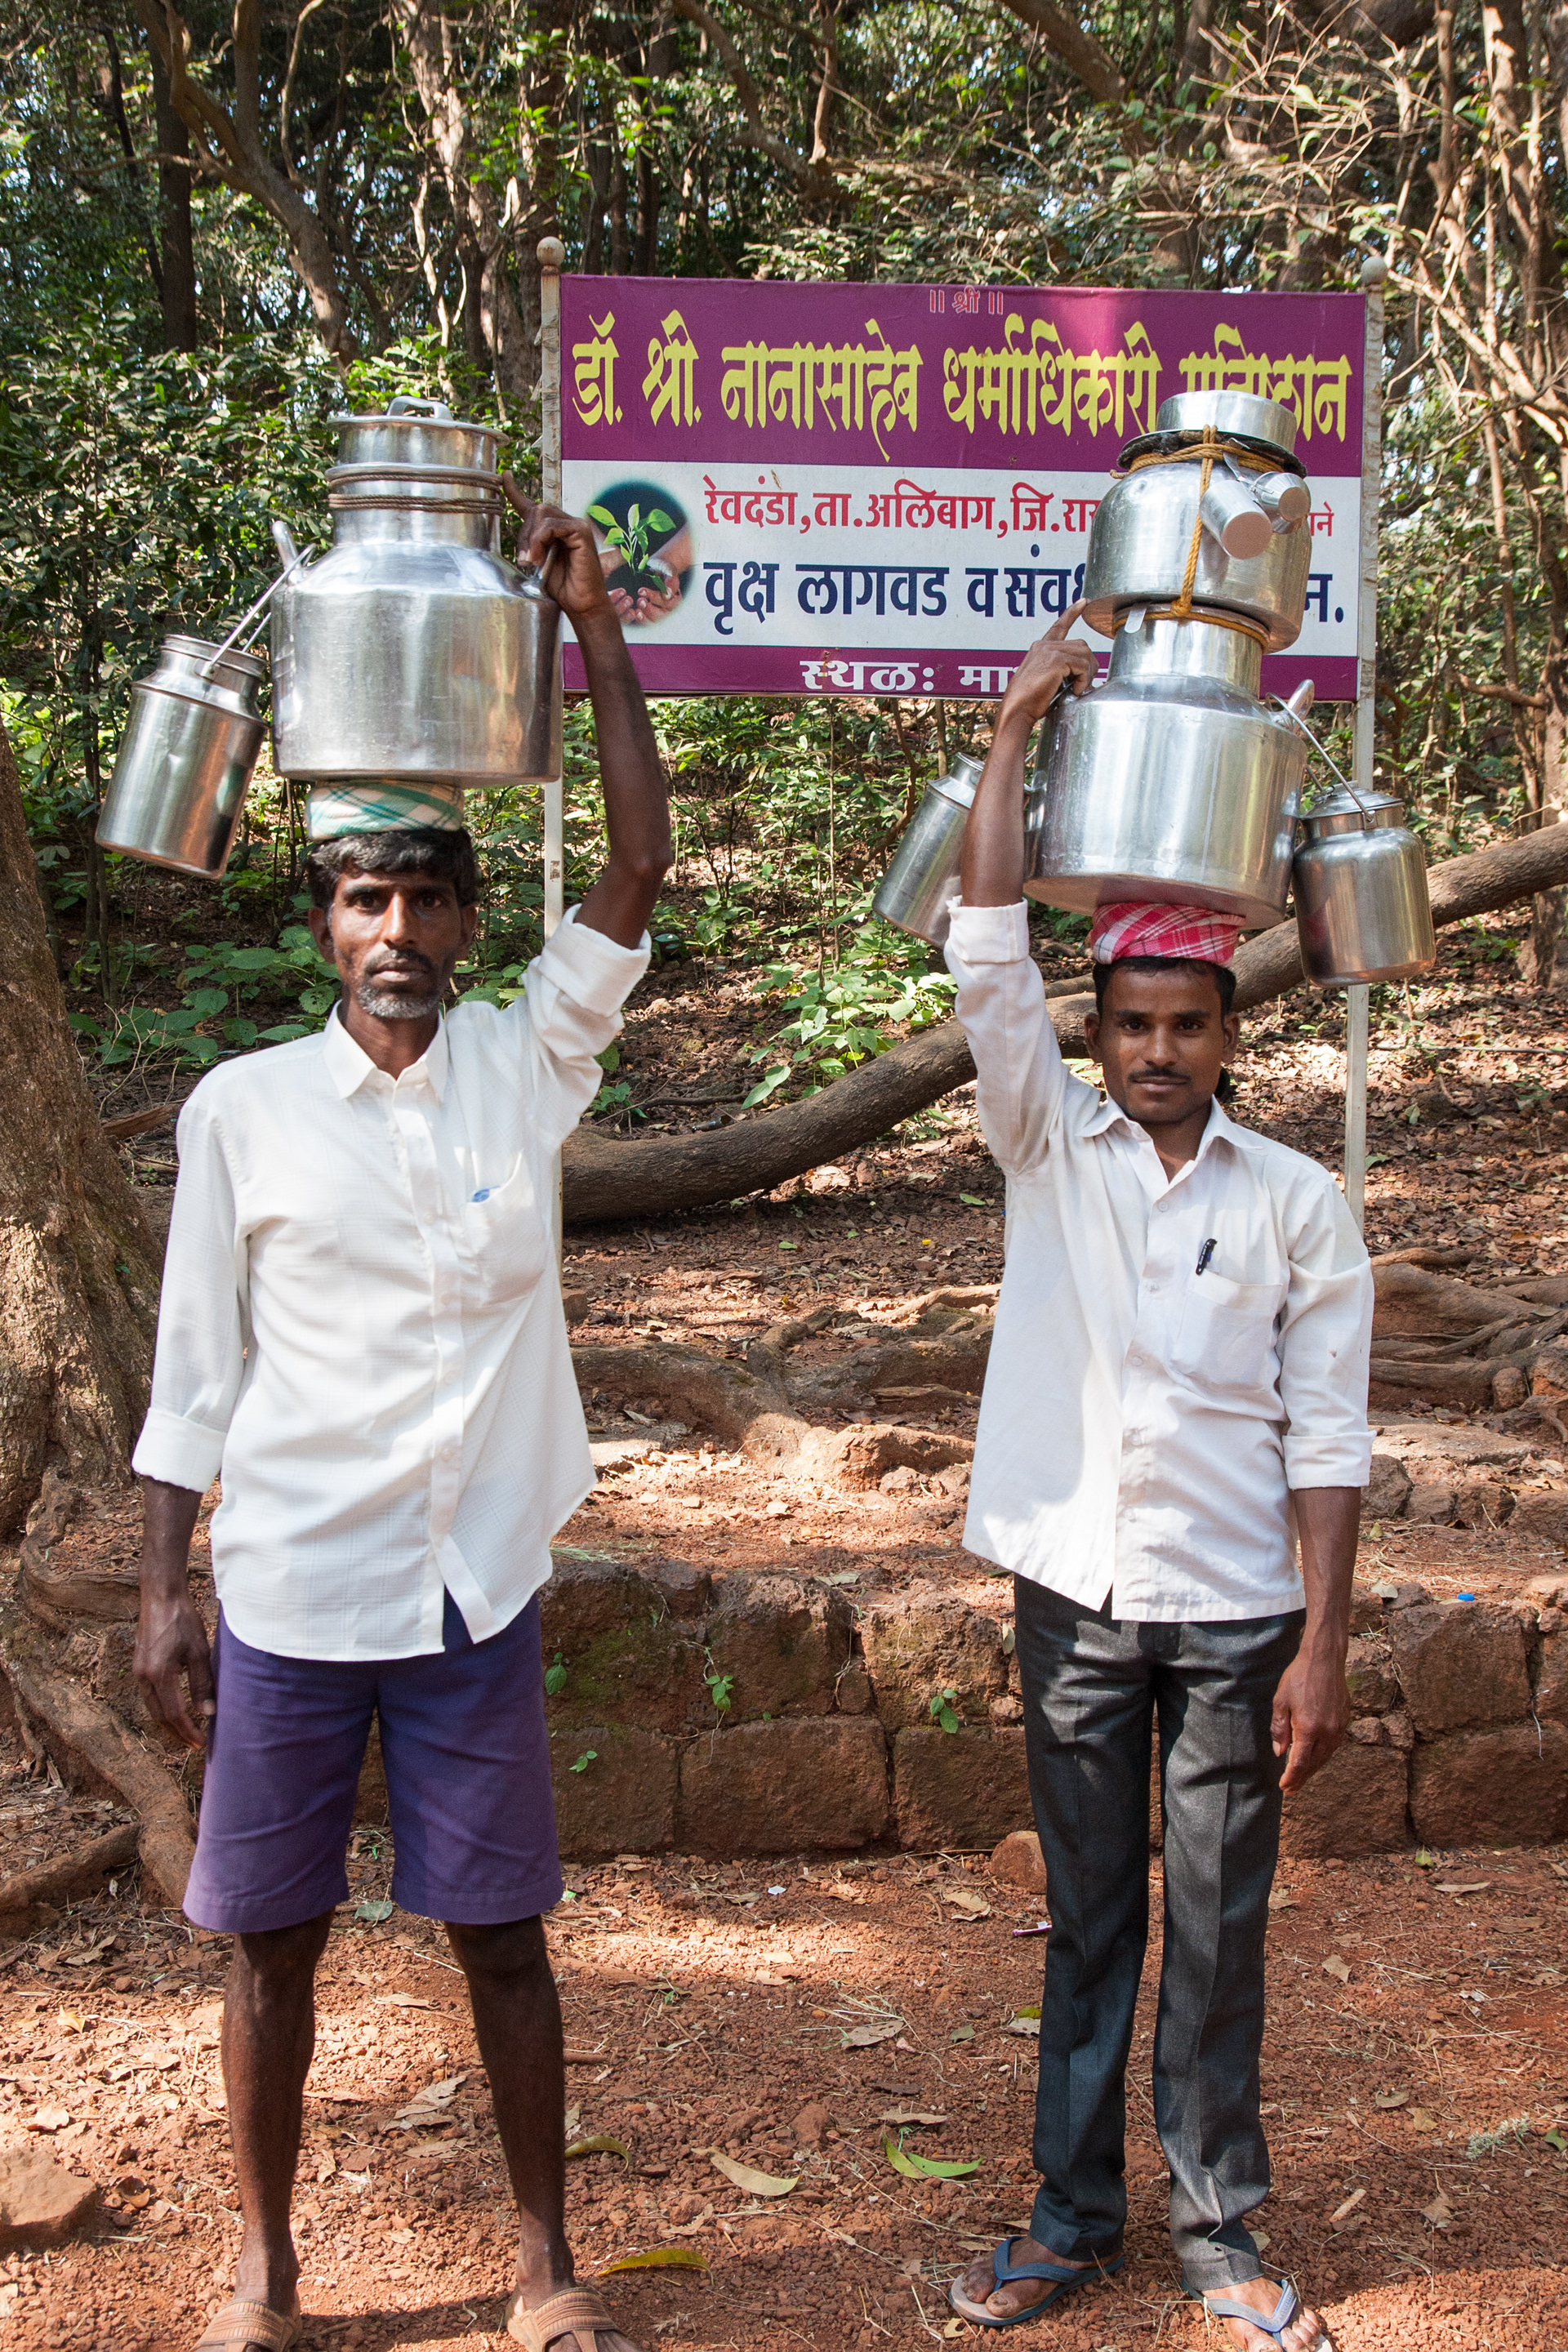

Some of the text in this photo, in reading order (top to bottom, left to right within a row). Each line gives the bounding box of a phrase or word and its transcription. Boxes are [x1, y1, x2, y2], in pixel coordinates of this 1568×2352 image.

[952, 285, 980, 314] श्री
[572, 311, 623, 426] डॉ.
[642, 310, 702, 427] श्री.
[720, 318, 924, 462] नानासाहेब
[943, 313, 1163, 436] धर्माधिकारी
[703, 561, 780, 635] वृक्ष
[795, 564, 950, 617] लागवड
